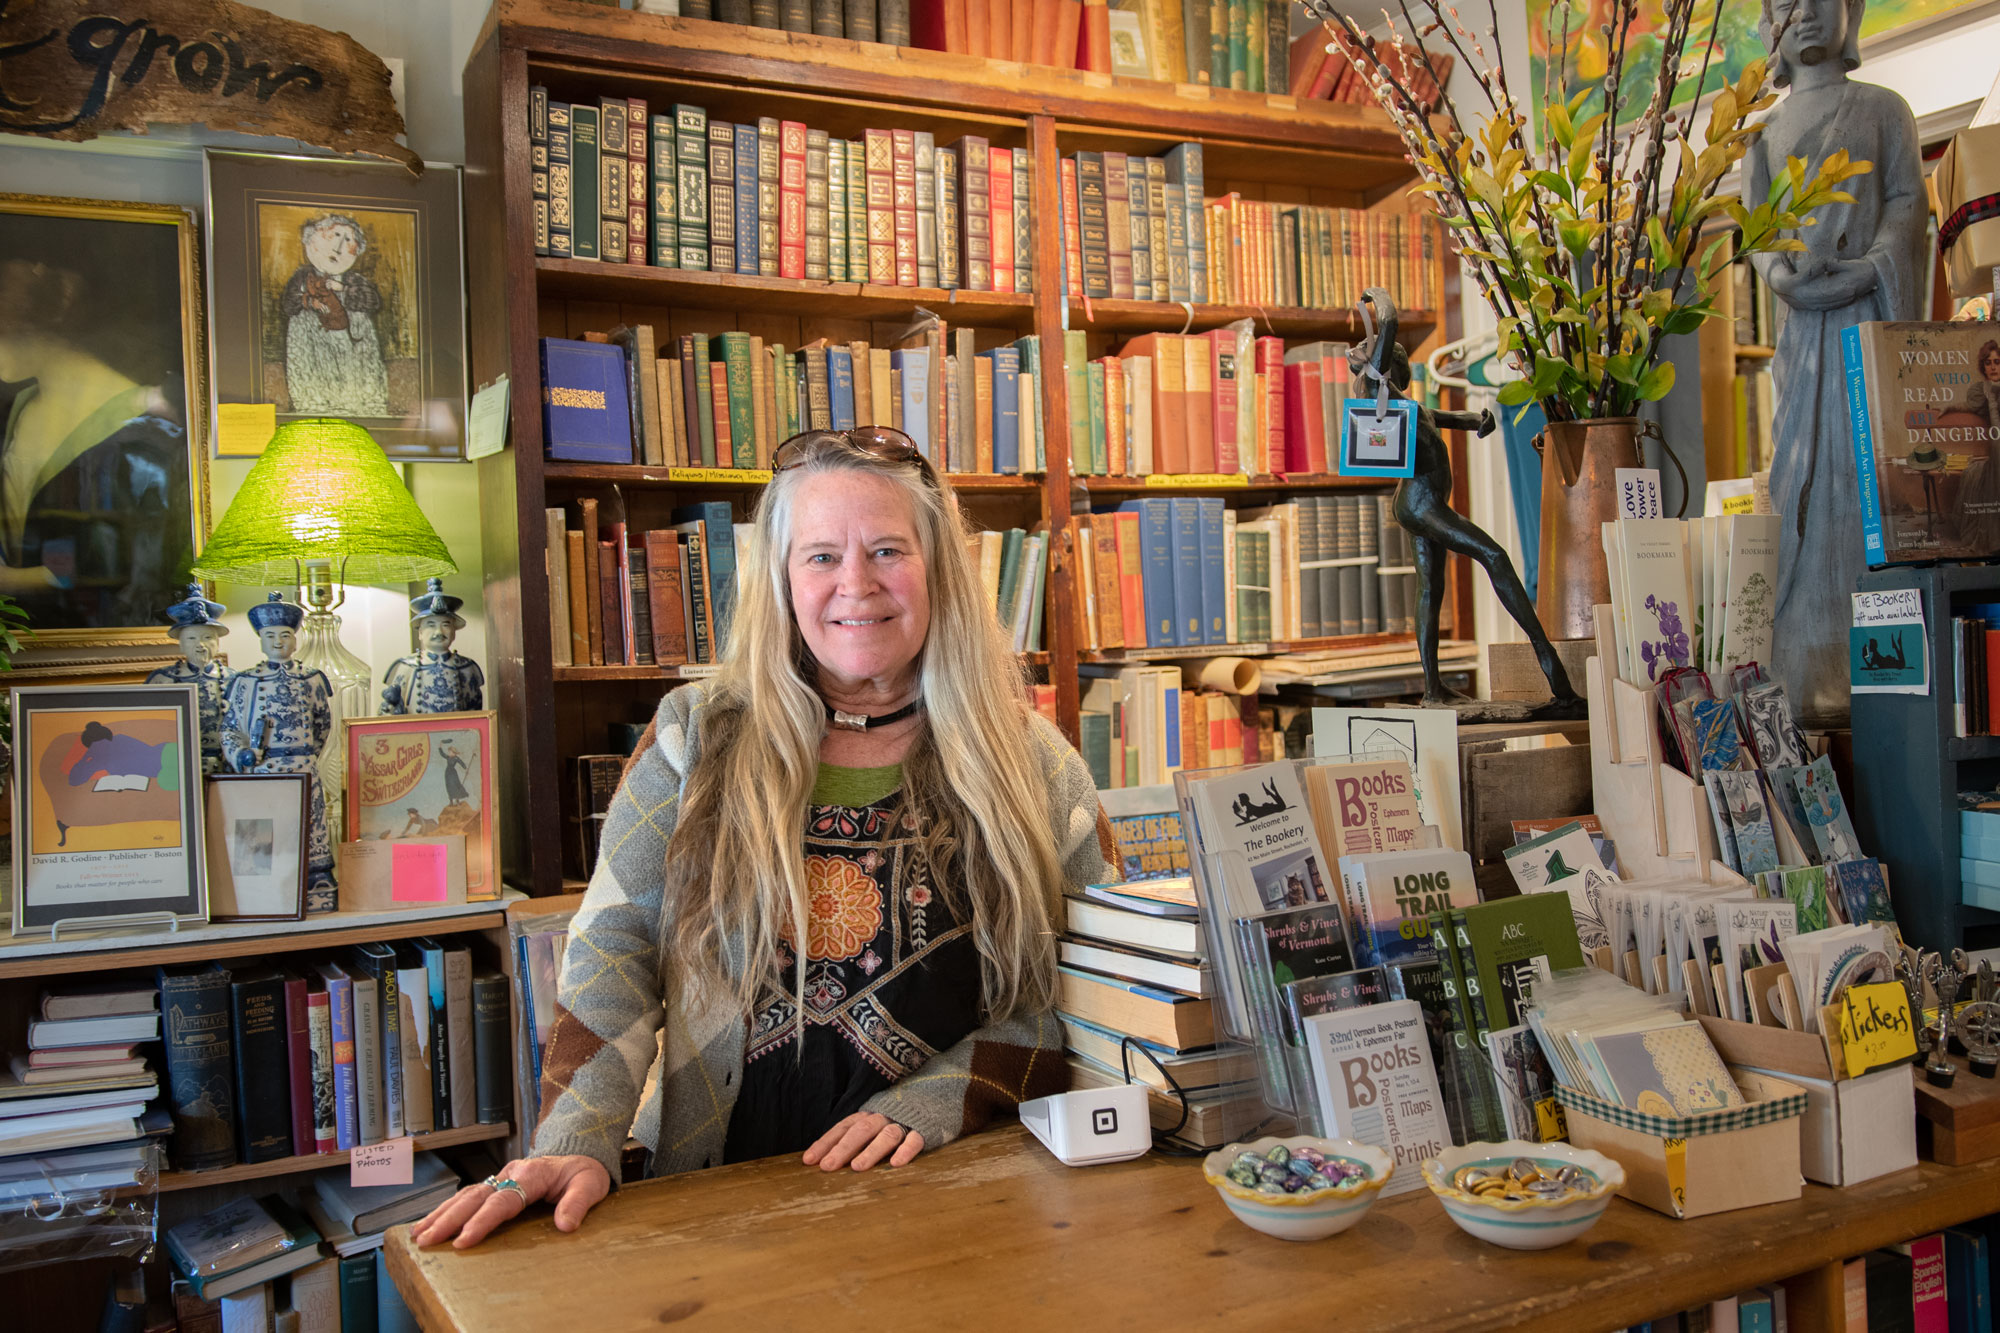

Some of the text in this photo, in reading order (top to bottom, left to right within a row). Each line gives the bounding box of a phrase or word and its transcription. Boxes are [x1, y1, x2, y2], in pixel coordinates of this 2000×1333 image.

[30, 15, 323, 132] grow
[1899, 350, 1970, 366] WOMEN
[1933, 372, 1971, 385] WHO
[1852, 375, 1862, 410] Women
[1903, 387, 1954, 403] READ
[1856, 409, 1864, 433] Who
[1906, 412, 1936, 426] ARE
[1859, 432, 1867, 456] Read
[1907, 425, 2000, 444] DANGERO
[1862, 473, 1874, 520] Dangerous
[1741, 548, 1774, 556] BOOKMARKS
[1854, 594, 1871, 608] THE
[375, 739, 390, 755] 3
[396, 743, 424, 770] GIRLS
[360, 752, 398, 777] VASSAR
[362, 758, 424, 802] SWITZERLAND
[1335, 770, 1406, 828] Books
[1249, 815, 1290, 833] Welcome to
[1383, 808, 1410, 820] Ephemera
[1244, 825, 1304, 853] The Bookery
[1386, 826, 1414, 844] Maps
[32, 850, 182, 865] David R. Godine Publisher Boston
[108, 880, 116, 888] for
[1393, 870, 1450, 896] LONG
[1395, 892, 1456, 918] TRAIL
[1264, 917, 1340, 939] Shrubs & Vines
[1361, 904, 1369, 926] TRAIL
[1366, 926, 1374, 951] GUIDE
[1502, 922, 1526, 940] ABC
[1278, 935, 1330, 951] of Vermont
[1327, 954, 1342, 962] Carter
[1434, 929, 1448, 949] A
[1443, 980, 1457, 998] B
[1456, 927, 1471, 946] A
[1466, 978, 1480, 996] B
[385, 970, 396, 1006] ABOUT
[1303, 982, 1382, 1006] Shrubs & Vines
[246, 994, 272, 1004] FEEDS
[246, 1006, 275, 1016] FEEDING
[387, 1008, 398, 1033] TIME
[1329, 1018, 1418, 1046] 32nd Vermont Book Postcard
[1356, 1040, 1361, 1048] &
[1362, 1036, 1392, 1049] Ephemera
[1394, 1030, 1406, 1041] Fair
[388, 1046, 398, 1070] PAUL
[1340, 1044, 1422, 1110] Books
[391, 1072, 400, 1105] DAVIES
[343, 1066, 354, 1136] In the Meantime
[1378, 1077, 1401, 1145] Postcards
[1400, 1100, 1433, 1118] Maps
[355, 1144, 395, 1157] LISTED
[1394, 1139, 1442, 1167] Prints
[356, 1157, 392, 1169] PHOTOS
[1914, 1254, 1941, 1266] Webster's
[1913, 1263, 1944, 1280] Spanish
[1914, 1276, 1942, 1293] English
[1916, 1290, 1944, 1303] Dictionary
